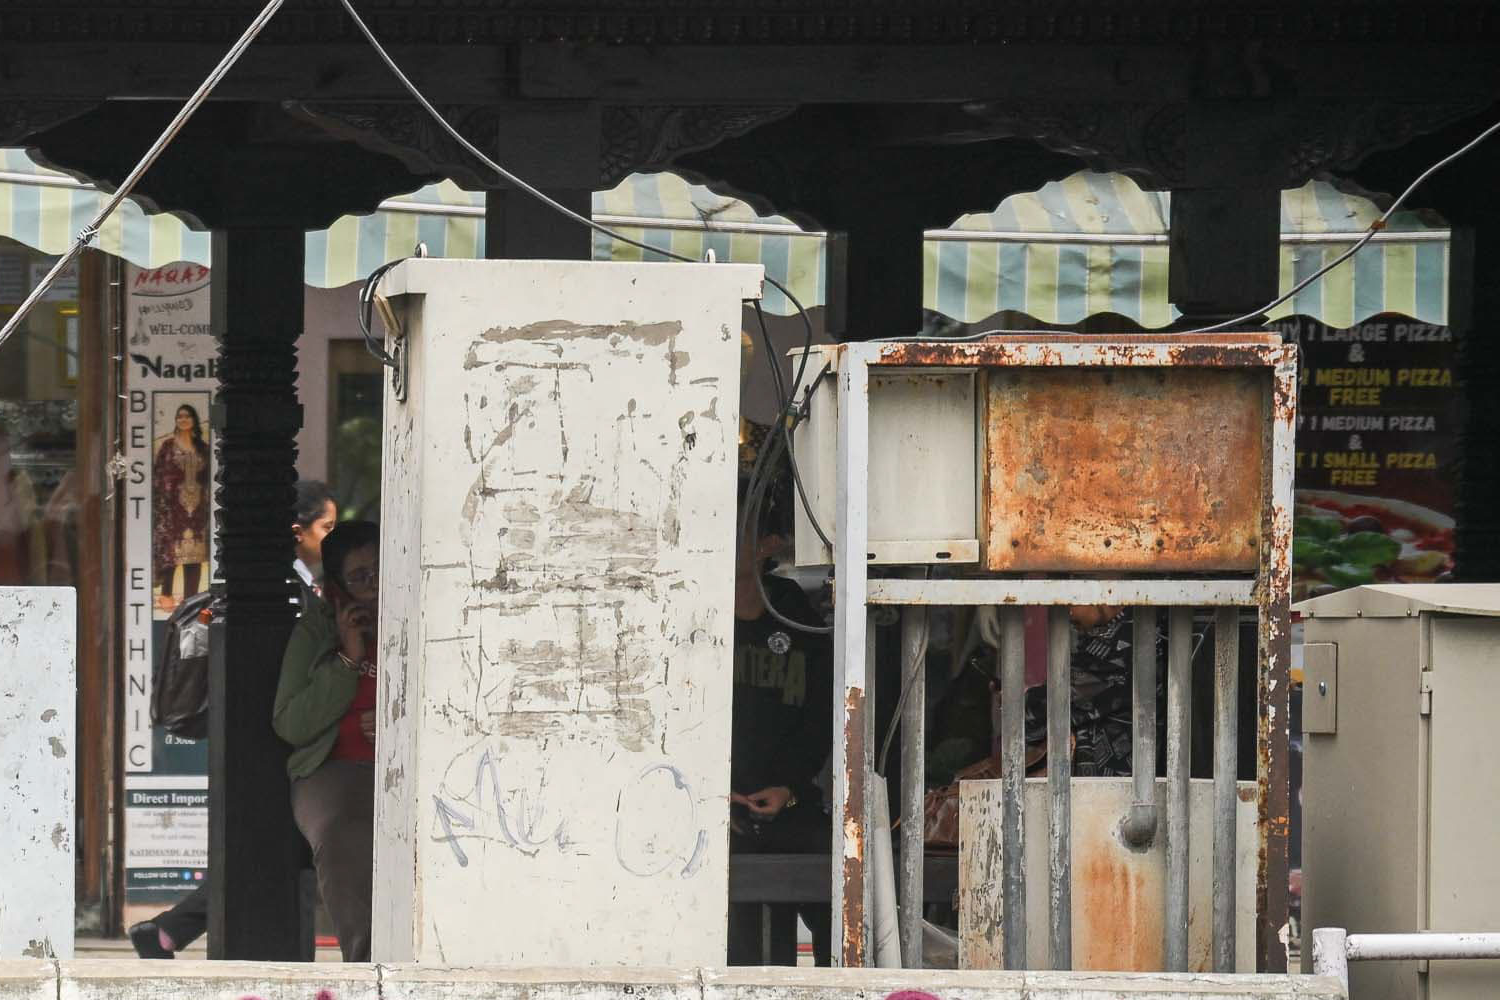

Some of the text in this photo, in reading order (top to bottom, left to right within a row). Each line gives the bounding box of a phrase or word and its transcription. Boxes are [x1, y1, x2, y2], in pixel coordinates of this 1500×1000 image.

[1321, 323, 1388, 341] LARGE
[1394, 323, 1453, 341] PIZZA
[1348, 343, 1365, 362] &
[1315, 368, 1391, 386] MEDIUM
[1397, 368, 1453, 386] PIZZA
[1329, 388, 1382, 406] FREE
[1322, 416, 1385, 431] MEDIUM
[1389, 416, 1436, 431] PIZZA
[1349, 434, 1363, 450] &
[129, 390, 147, 520] BEST
[1323, 452, 1381, 468] SMALL
[1386, 452, 1438, 468] PIZZA
[1330, 470, 1379, 485] FREE
[129, 567, 147, 767] ETHNIC
[132, 793, 169, 804] Direct
